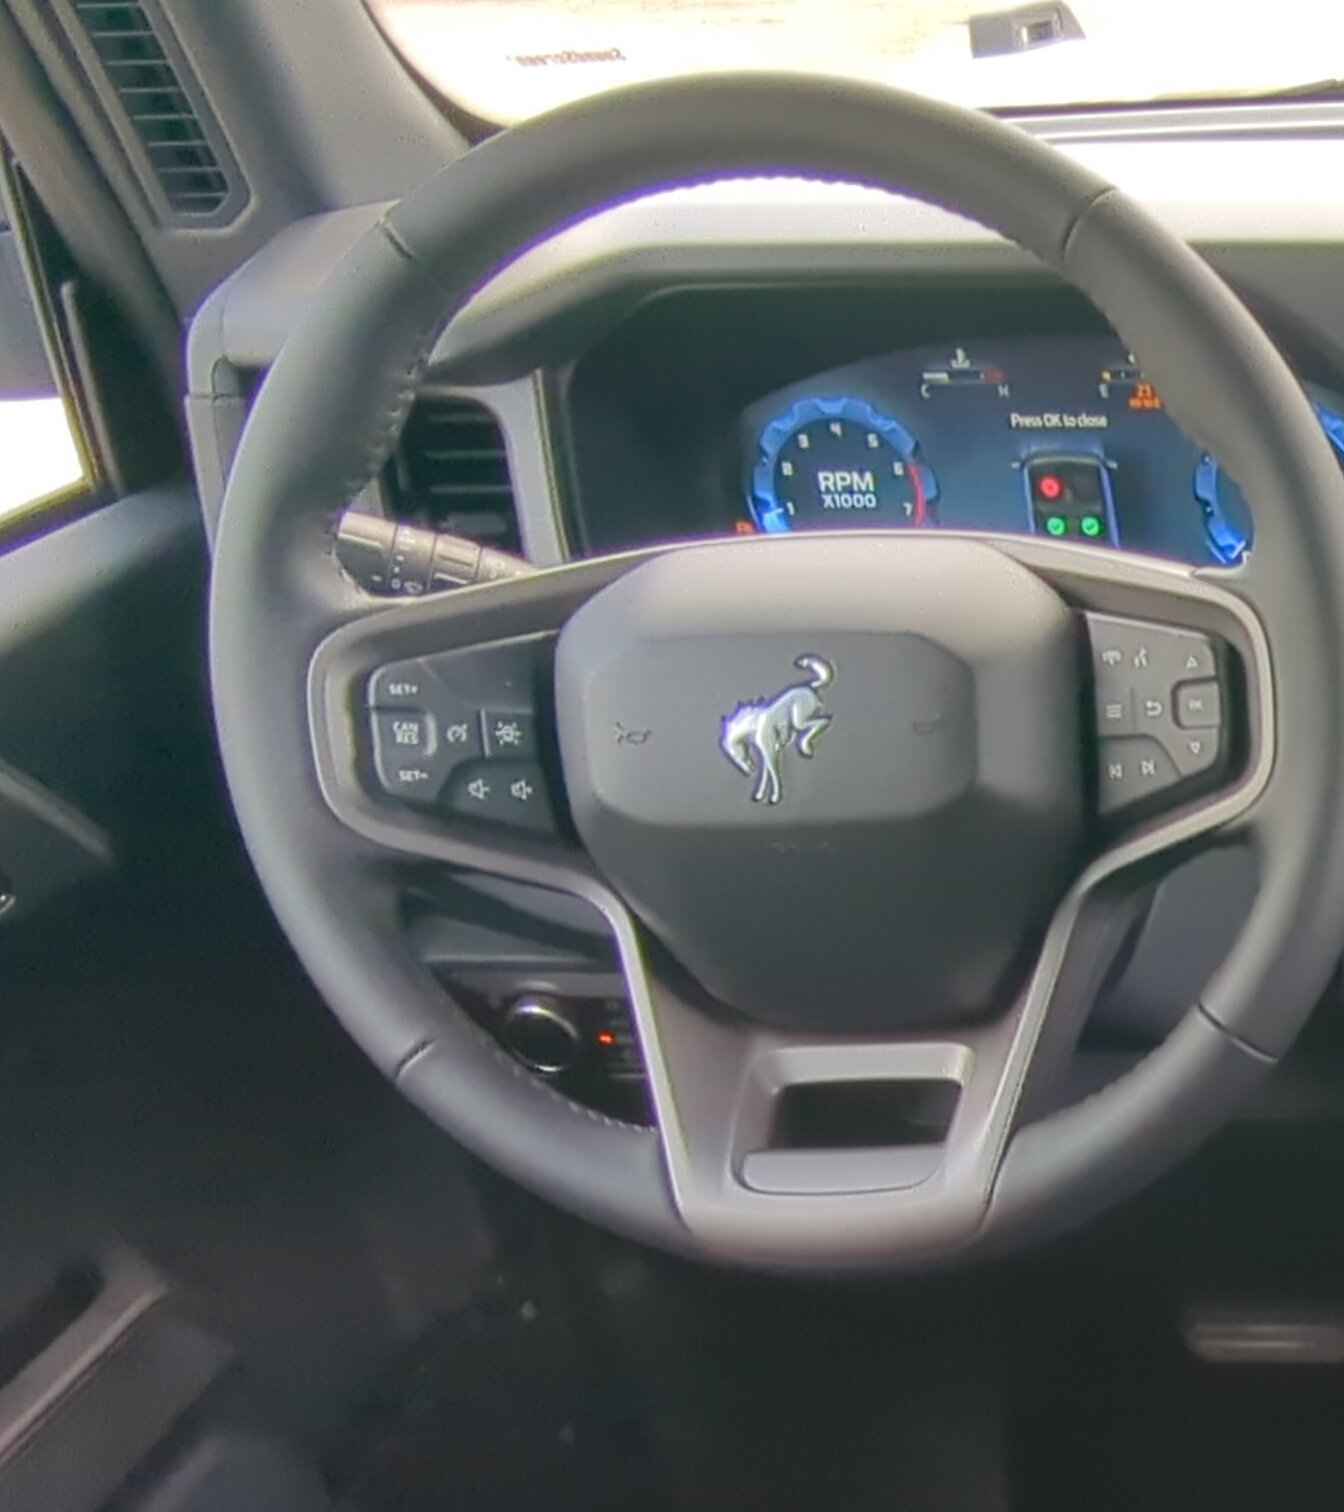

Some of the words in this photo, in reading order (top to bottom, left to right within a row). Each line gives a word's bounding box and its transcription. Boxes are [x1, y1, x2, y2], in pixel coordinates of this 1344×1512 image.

[1010, 413, 1043, 428] Press
[1044, 413, 1062, 428] OK
[1064, 414, 1076, 428] to
[1078, 413, 1107, 428] close
[829, 422, 842, 437] 4
[798, 434, 809, 448] 3
[867, 433, 879, 448] 5
[893, 461, 904, 476] 6
[817, 470, 874, 492] RPM
[786, 502, 795, 516] 1
[822, 494, 876, 509] X1000
[903, 502, 913, 517] 7
